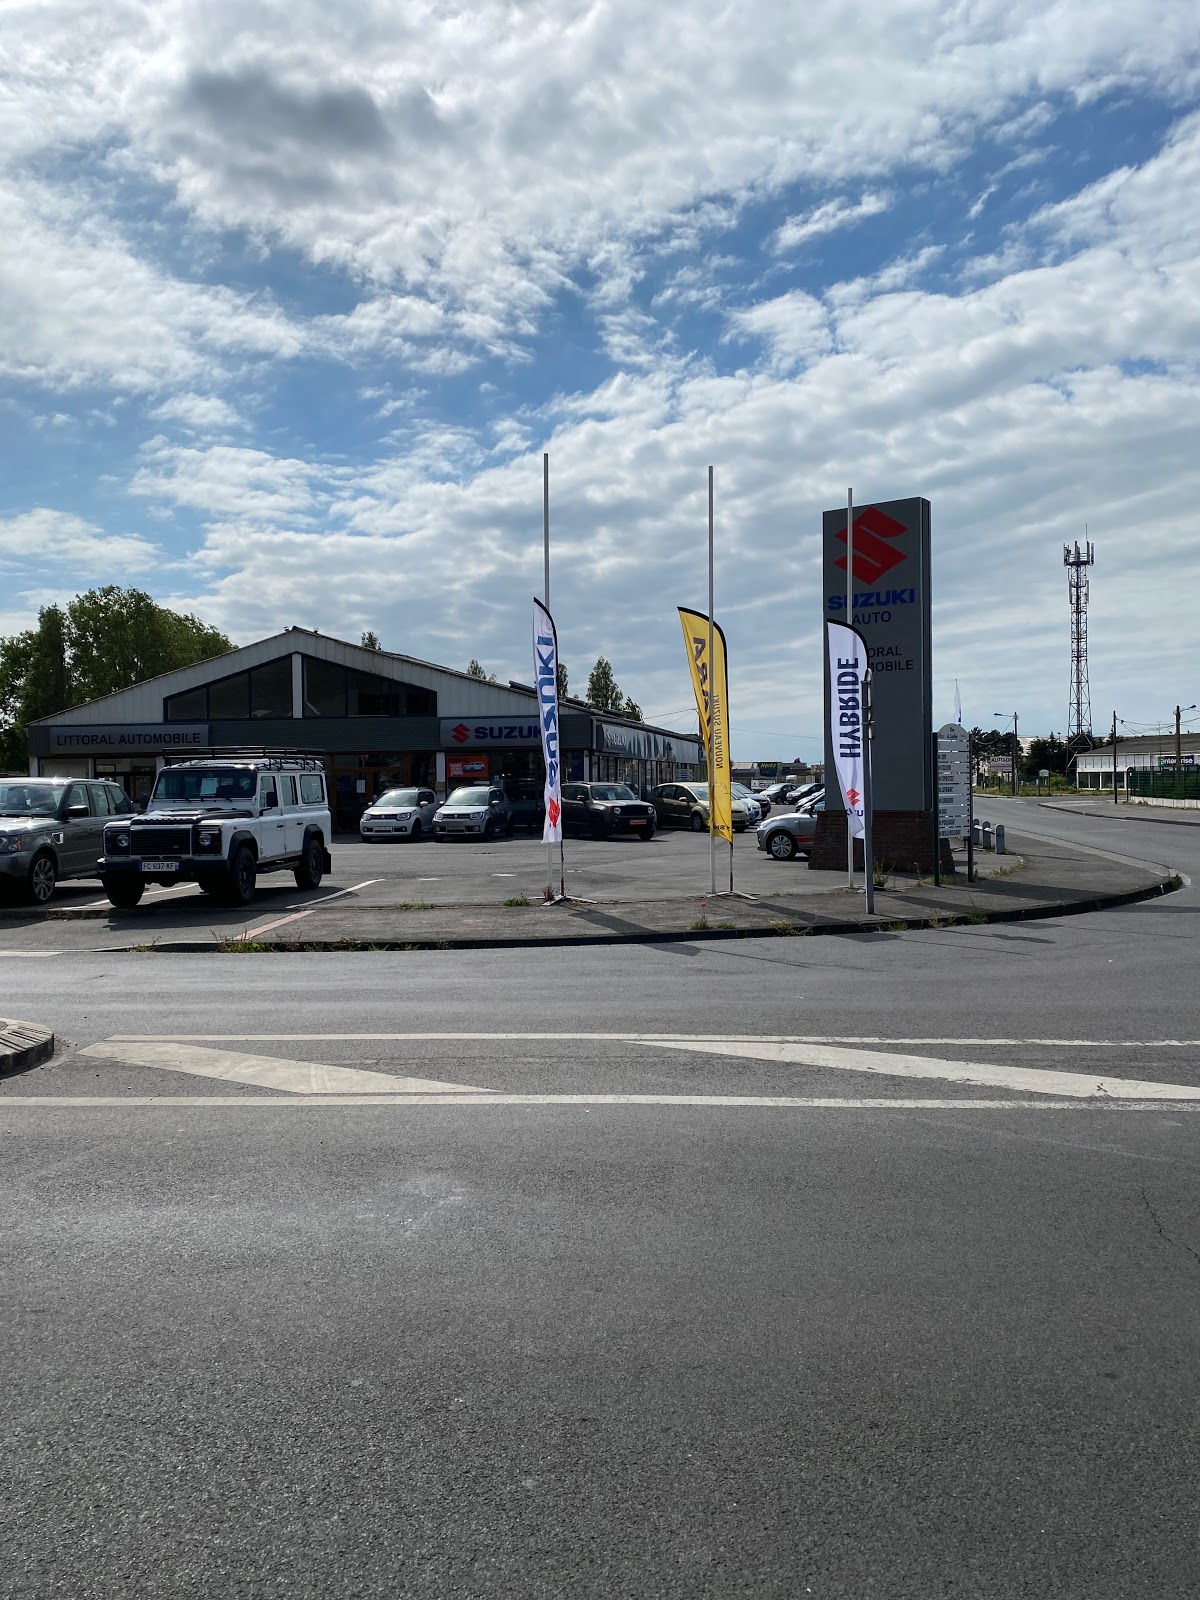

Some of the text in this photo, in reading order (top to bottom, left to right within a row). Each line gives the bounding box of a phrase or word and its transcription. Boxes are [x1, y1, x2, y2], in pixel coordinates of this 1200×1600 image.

[827, 588, 916, 611] SUZUKI
[852, 611, 892, 625] AUTO
[868, 646, 902, 658] ORAL
[56, 732, 201, 746] LITTORAL AUTOMOBILE
[1160, 757, 1194, 765] enterrise
